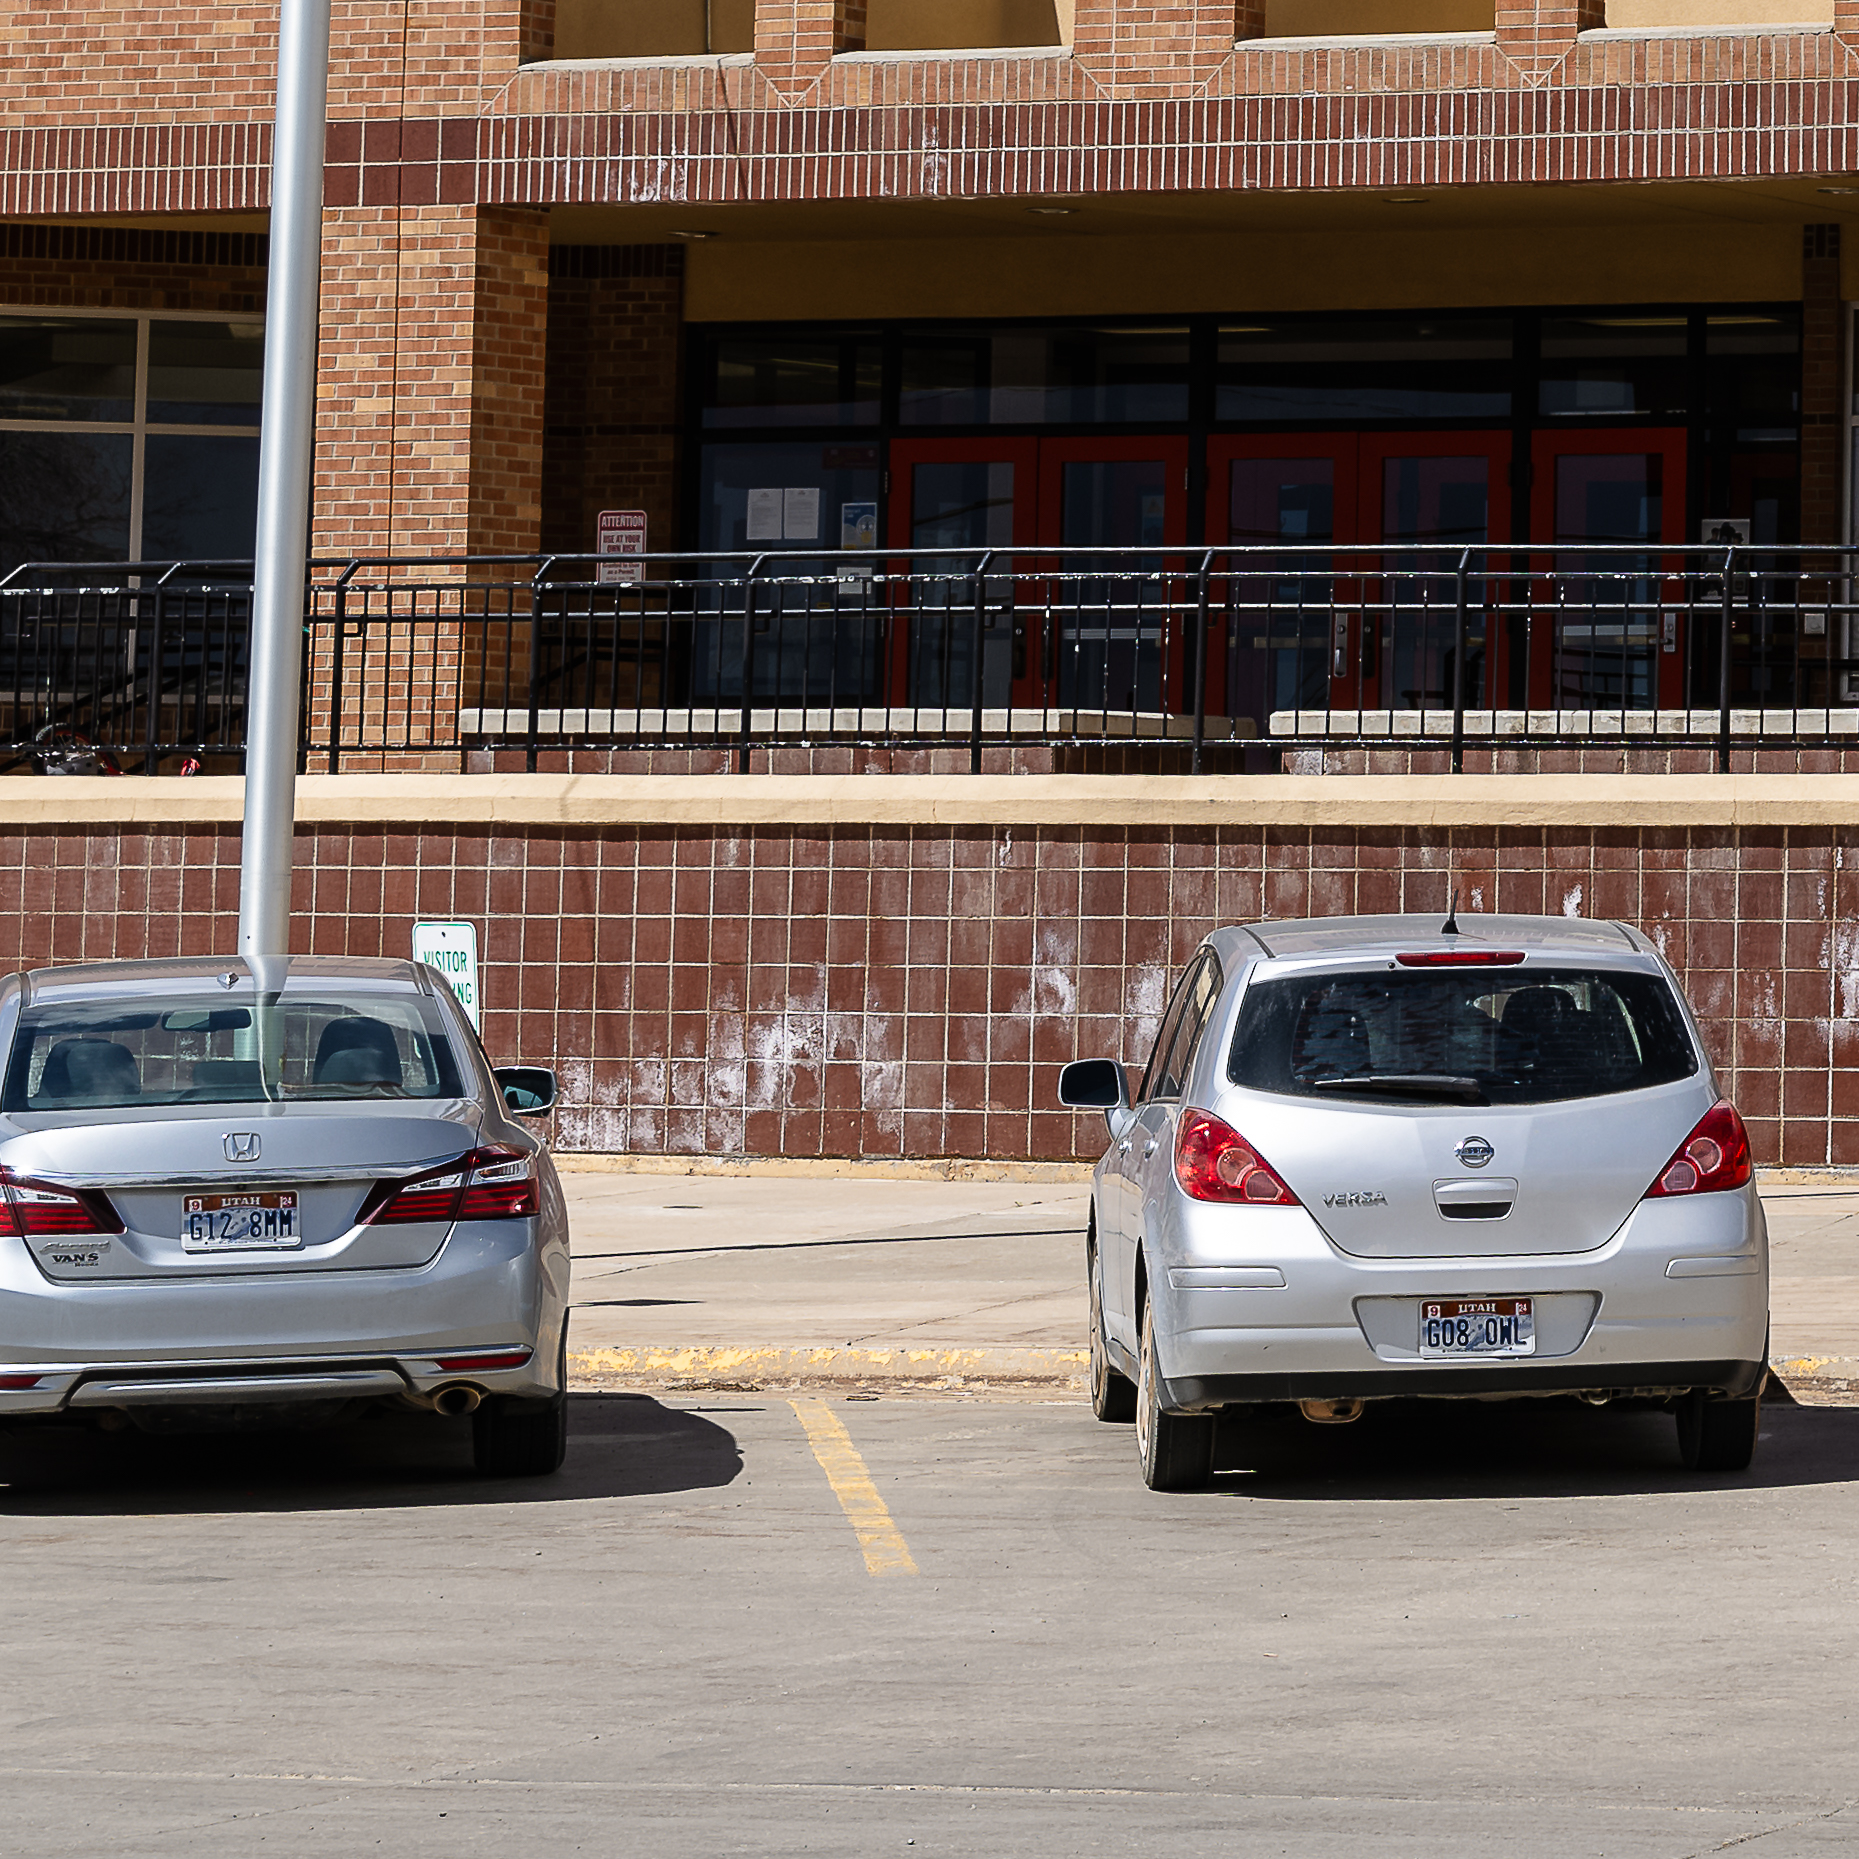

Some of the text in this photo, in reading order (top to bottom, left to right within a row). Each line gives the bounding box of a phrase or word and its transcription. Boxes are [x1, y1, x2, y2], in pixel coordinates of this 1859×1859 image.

[601, 515, 644, 527] ATTENTION
[603, 534, 640, 543] USE AT YOUR
[423, 950, 467, 972] VISITOR
[221, 1196, 261, 1207] UTAH
[1321, 1191, 1388, 1208] VERSA
[189, 1209, 292, 1240] G12 8MM
[1457, 1303, 1496, 1313] UTAH
